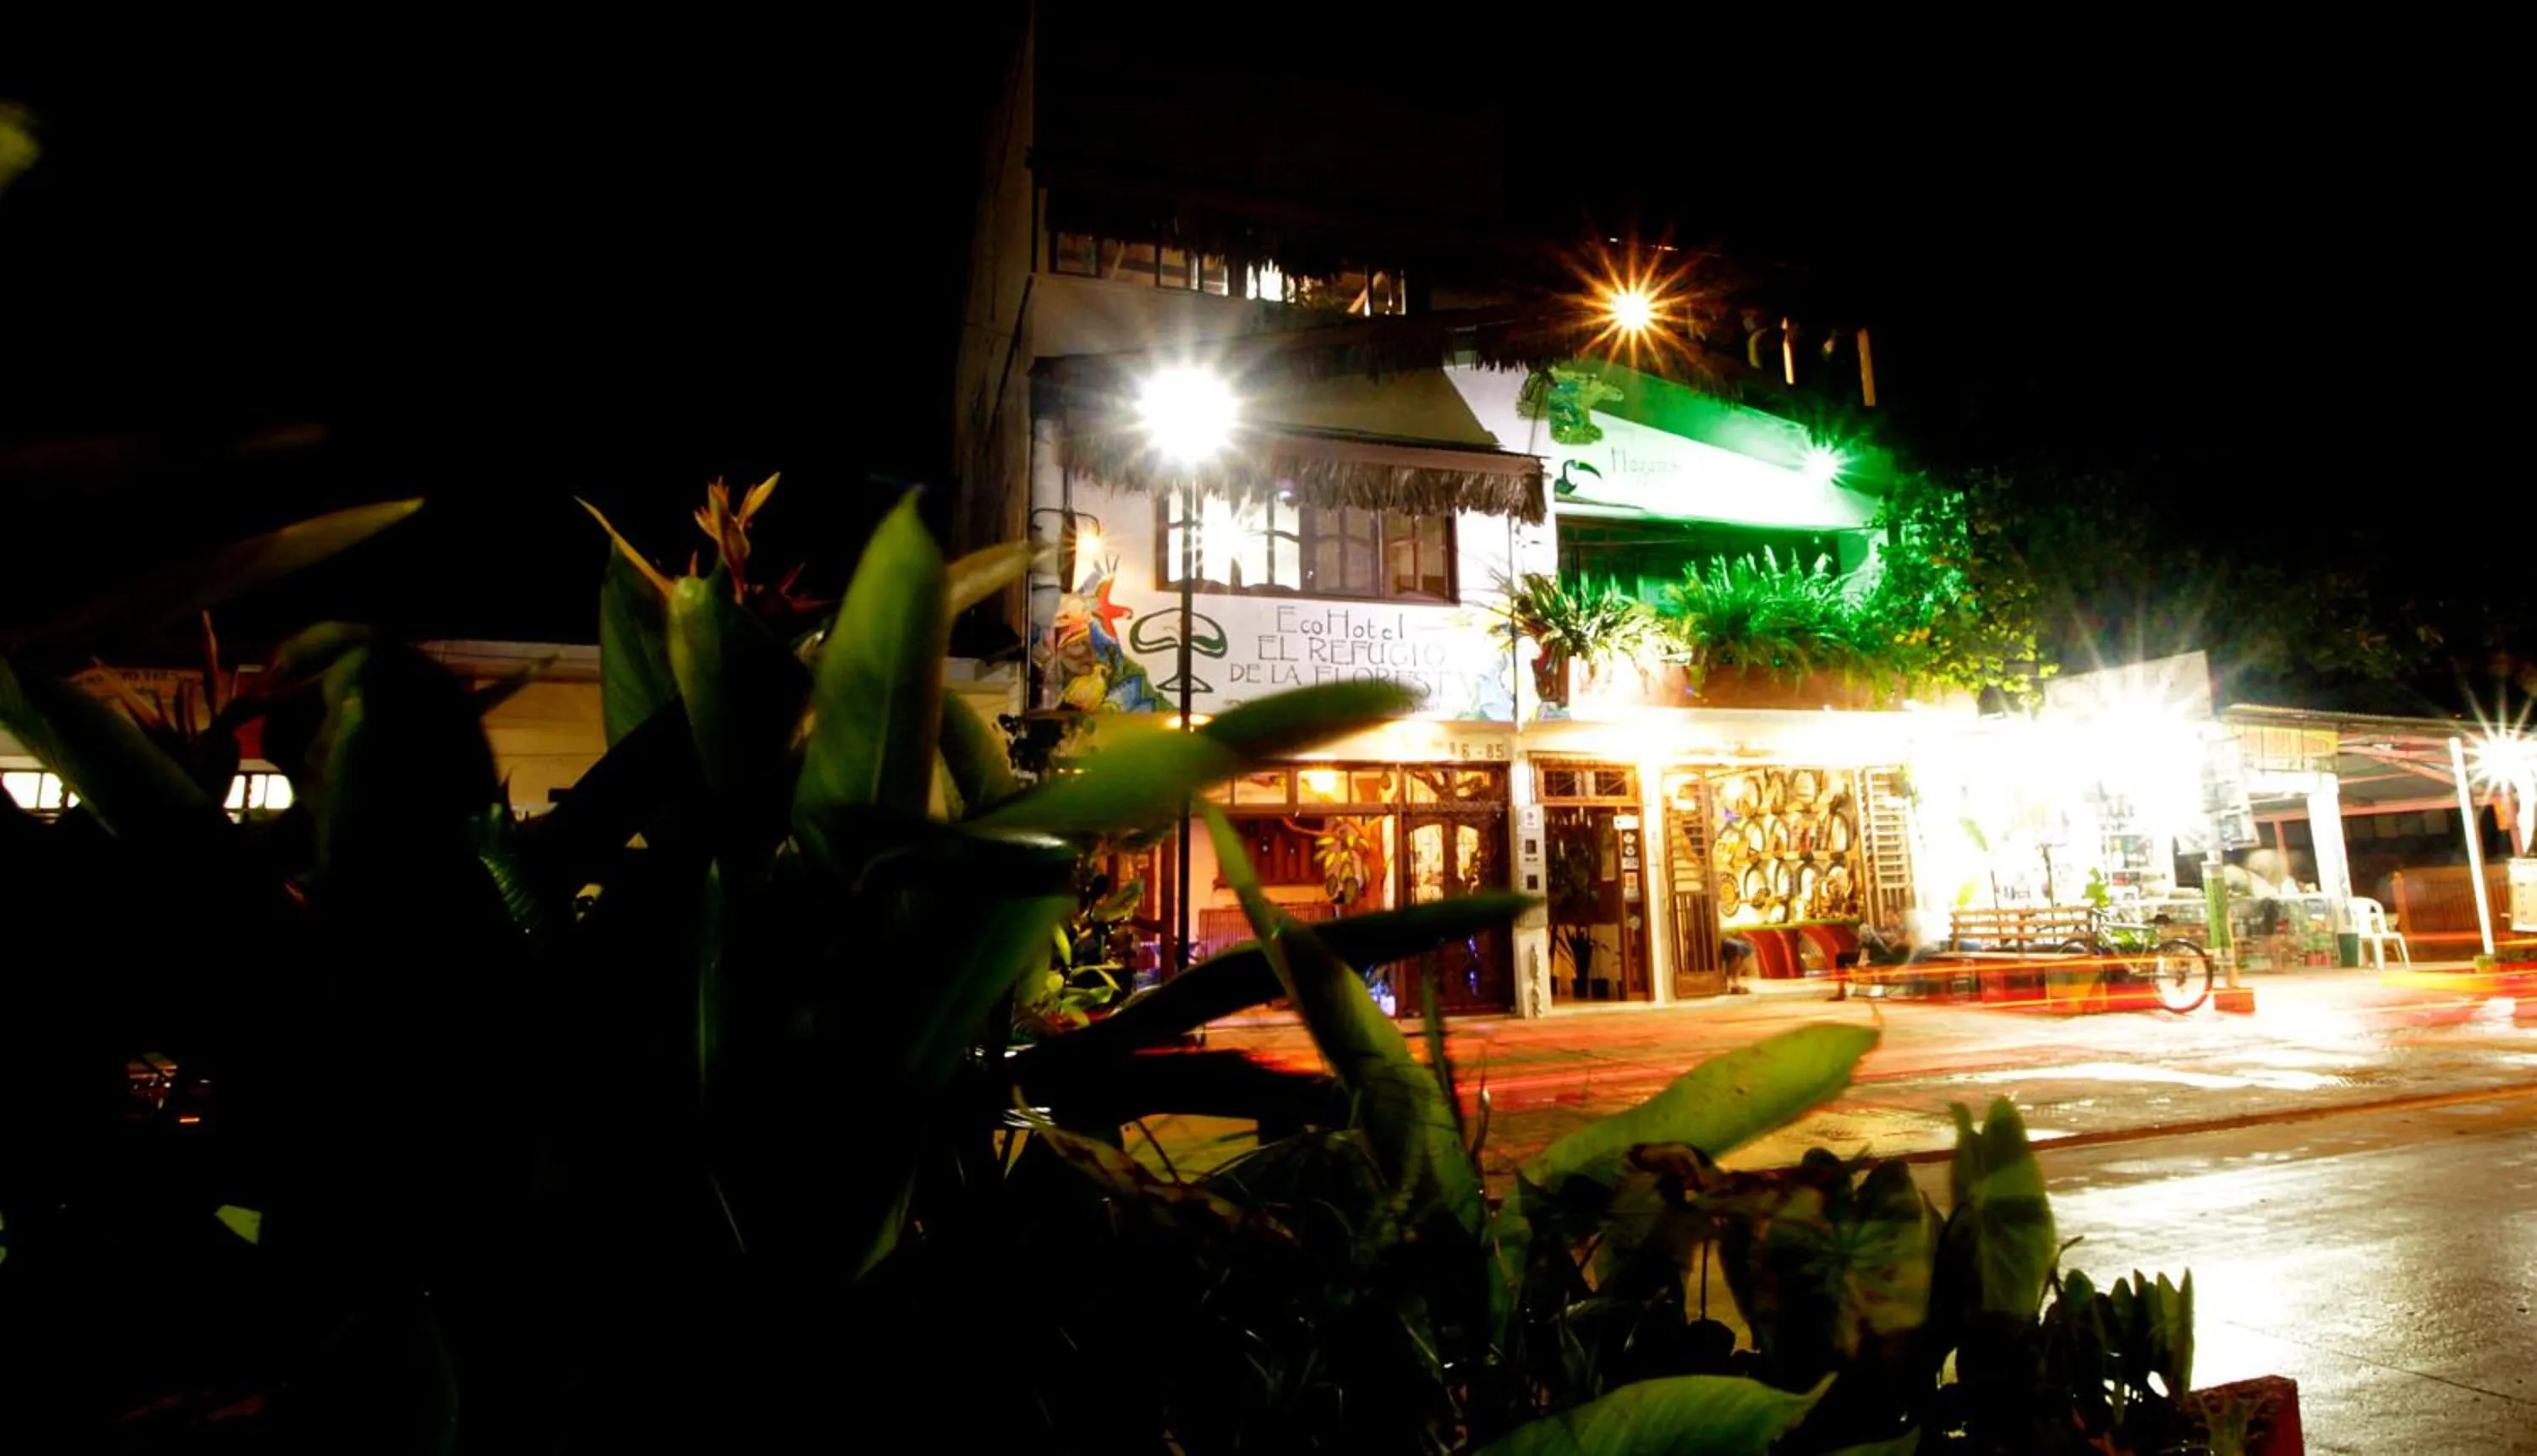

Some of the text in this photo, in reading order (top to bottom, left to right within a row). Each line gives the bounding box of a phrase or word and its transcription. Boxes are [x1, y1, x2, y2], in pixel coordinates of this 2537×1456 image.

[1258, 634, 1445, 667] EL REFUGIO
[1230, 663, 1261, 683] DE
[1272, 664, 1301, 686] LA
